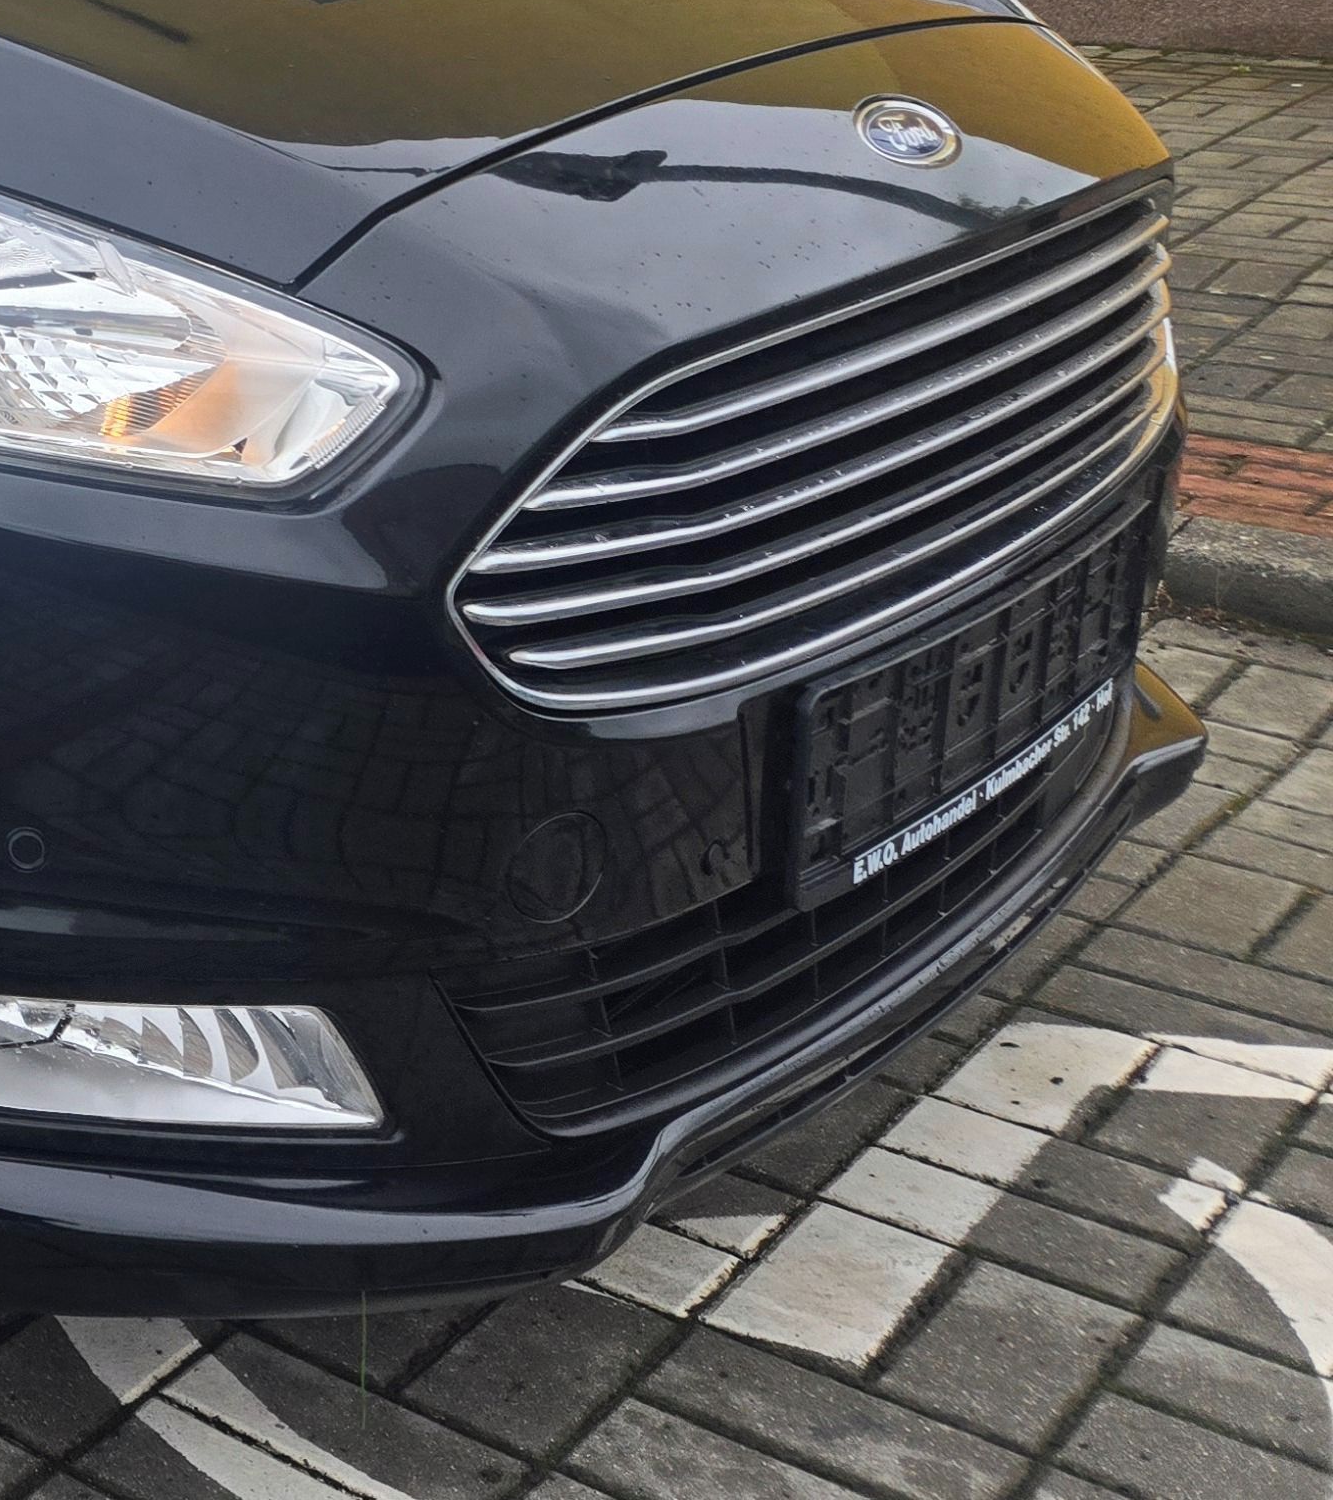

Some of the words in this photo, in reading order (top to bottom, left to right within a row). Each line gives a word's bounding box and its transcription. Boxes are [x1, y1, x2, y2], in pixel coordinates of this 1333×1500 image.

[878, 114, 940, 151] Ford
[853, 841, 898, 884] E.W.O.
[901, 789, 976, 855] Autohandel
[986, 738, 1052, 800] Kulmbacher
